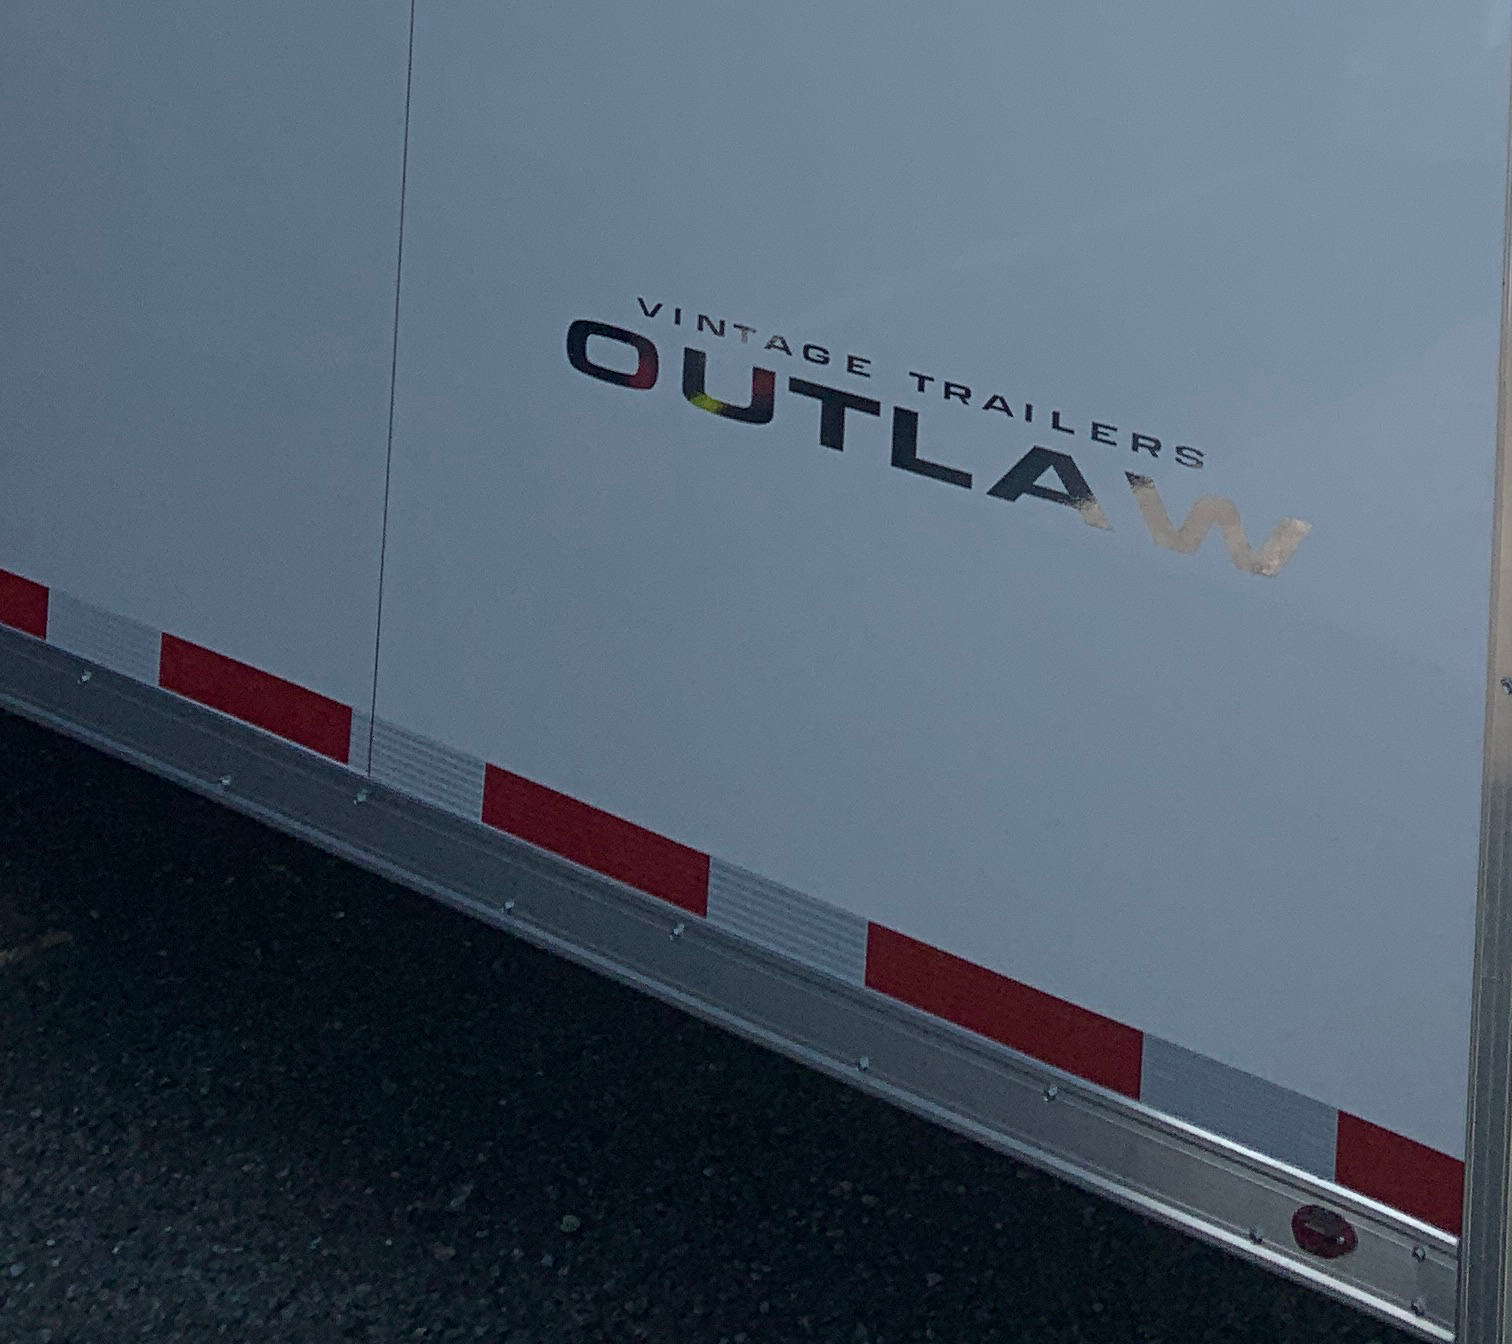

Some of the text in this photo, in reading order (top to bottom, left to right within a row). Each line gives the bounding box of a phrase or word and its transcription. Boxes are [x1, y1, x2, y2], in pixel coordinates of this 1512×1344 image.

[565, 318, 1313, 579] OUTLAW
[637, 296, 1205, 469] VINTAGE TRAILERS
